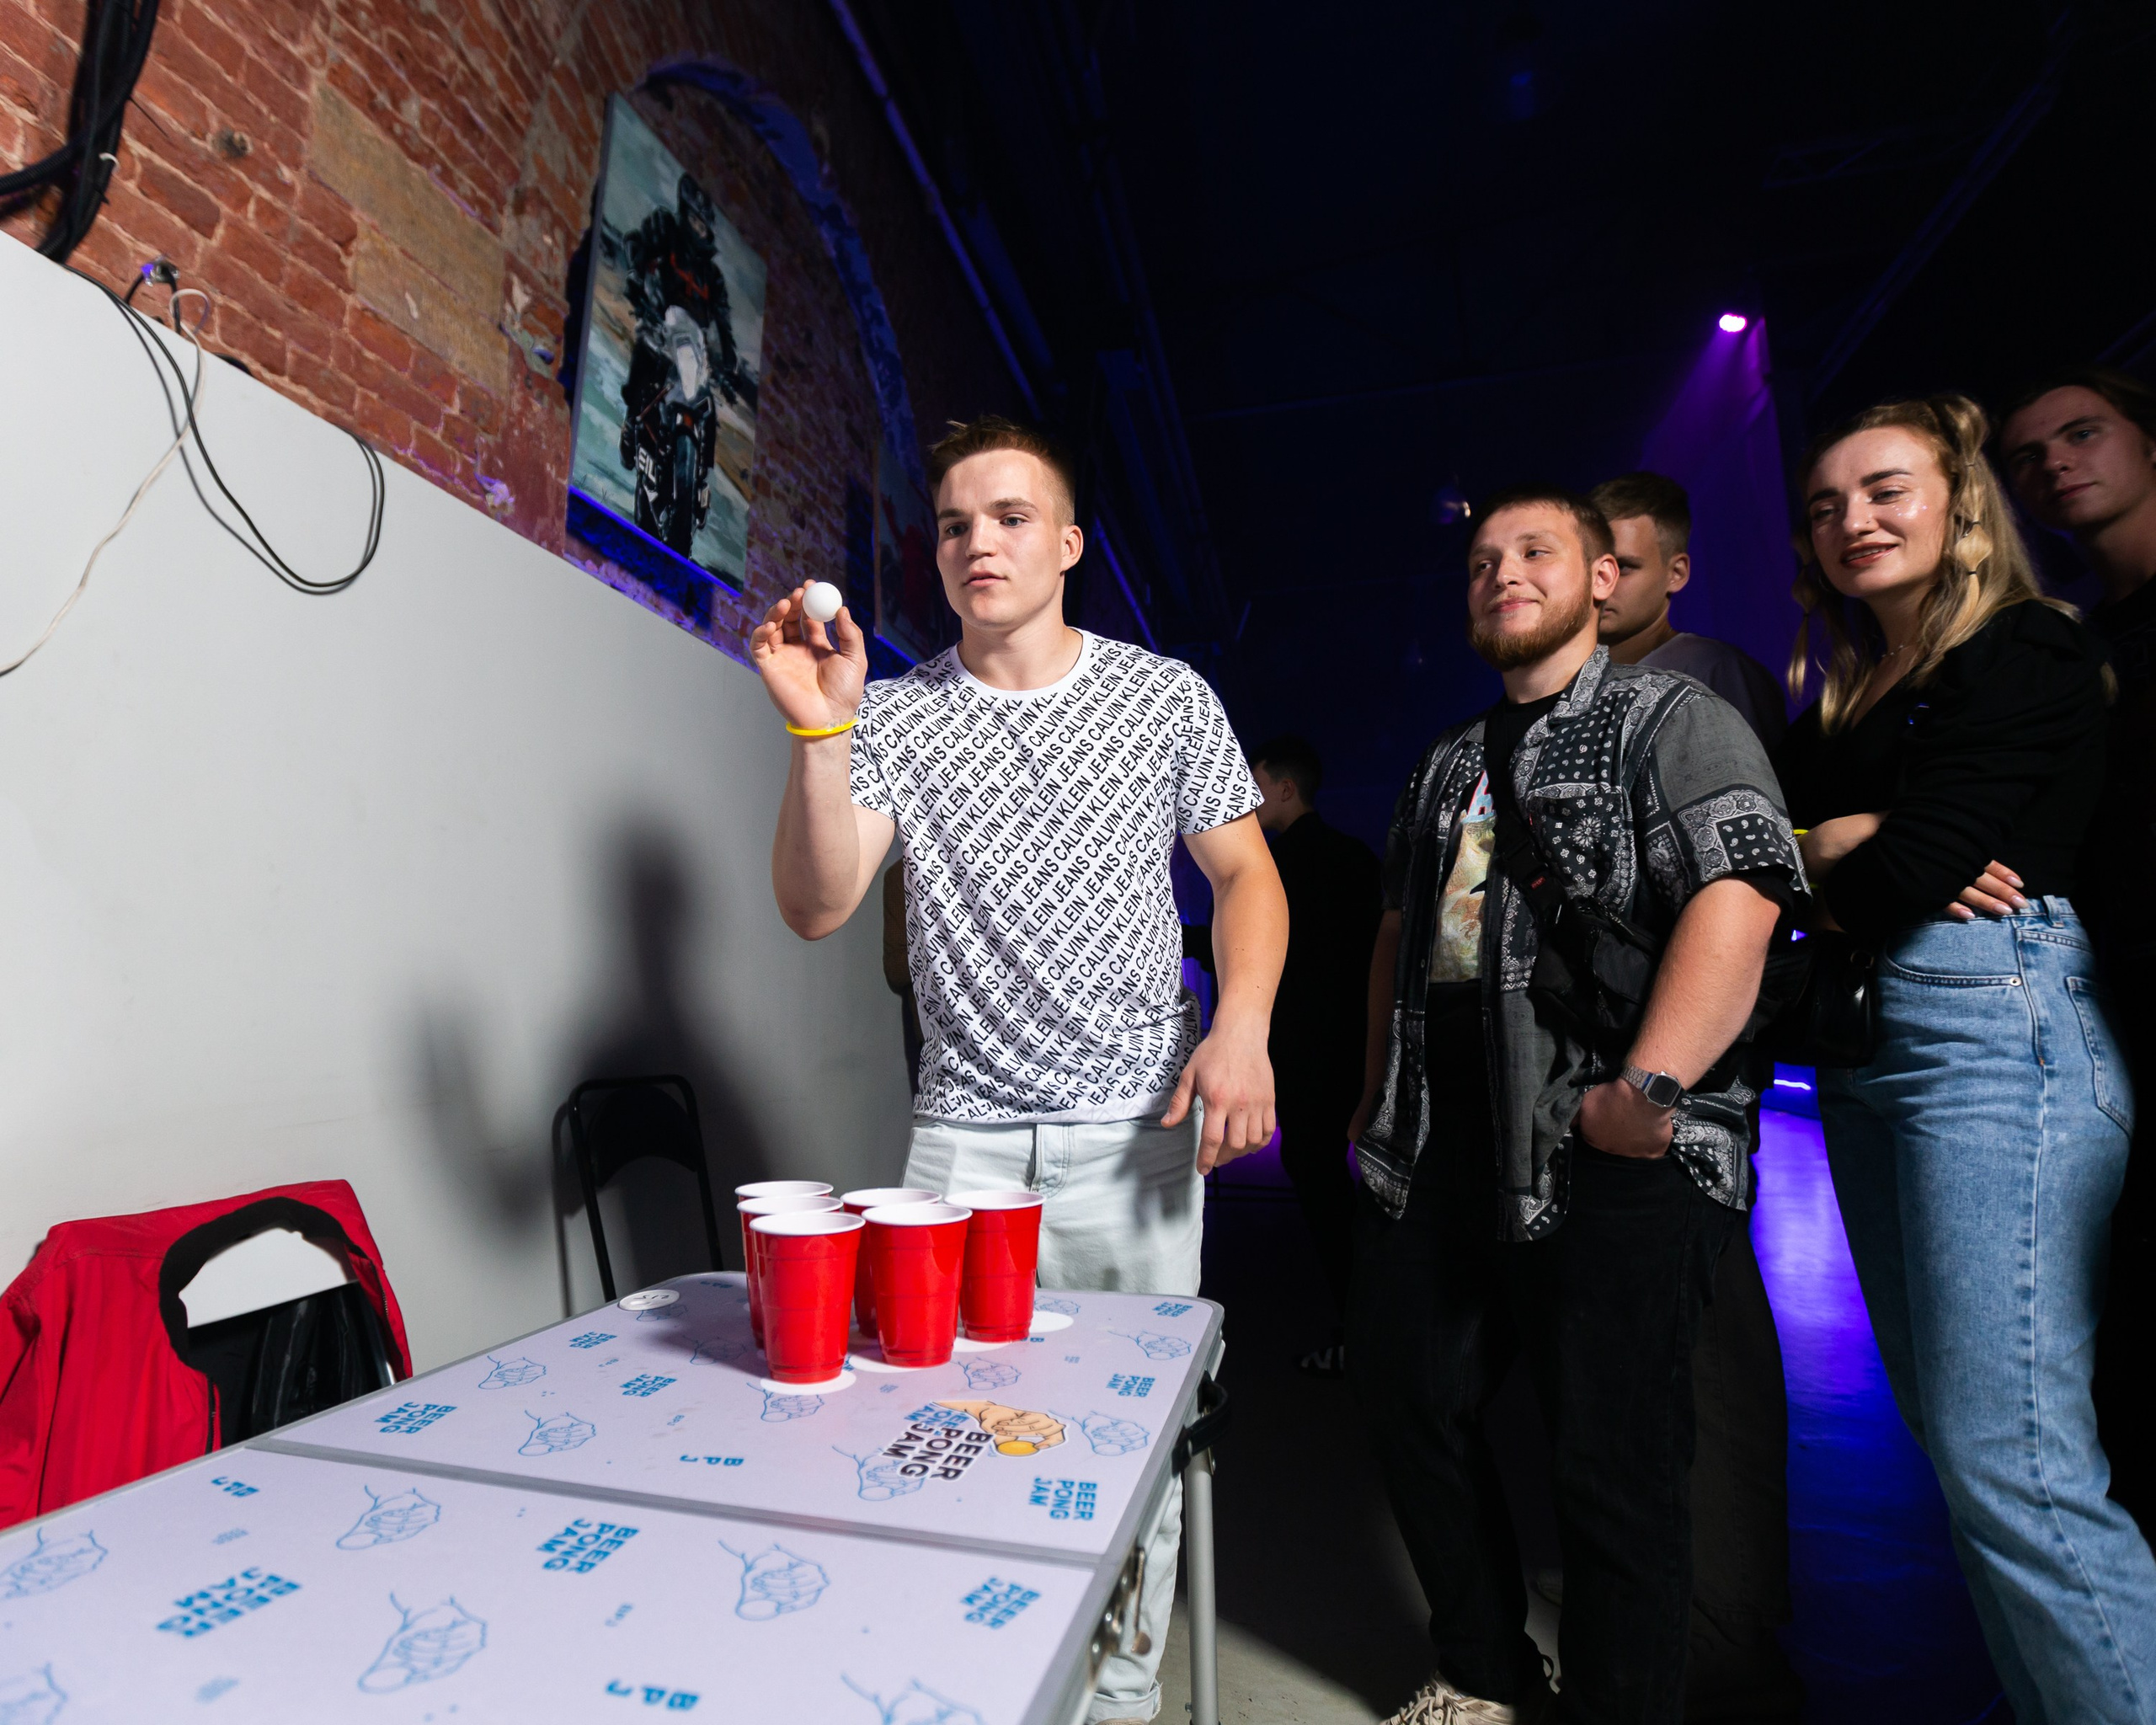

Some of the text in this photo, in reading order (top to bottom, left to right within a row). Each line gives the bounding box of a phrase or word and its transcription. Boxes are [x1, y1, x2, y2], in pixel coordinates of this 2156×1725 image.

[891, 685, 927, 713] KLEIN
[922, 661, 955, 693] JEANS
[884, 710, 925, 748] CALVIN
[921, 689, 952, 715] KLEIN
[1180, 695, 1194, 742] JEANS
[1181, 681, 1209, 770] KLEIN JEANS
[885, 745, 917, 786] JEANS
[914, 713, 953, 748] CALVIN
[910, 783, 942, 824] KLEIN
[940, 747, 975, 788] JEANS
[972, 708, 1008, 749] CALVIN
[911, 746, 946, 788] JEANS
[943, 710, 981, 748] CALVIN
[1182, 756, 1215, 807] CALVIN
[1205, 713, 1225, 756] KLEIN
[913, 818, 943, 861] CALVIN
[937, 783, 972, 824] KLEIN
[970, 747, 1006, 788] JEANS
[1001, 708, 1038, 750] CALVIN
[914, 860, 944, 901] JEANS
[938, 818, 972, 863] CALVIN
[967, 782, 1002, 823] KLEIN
[1001, 745, 1033, 787] JEANS
[1029, 707, 1067, 746] CALVIN
[1060, 675, 1093, 708] KLEIN
[1090, 649, 1121, 679] JEANS
[1193, 796, 1221, 834] EANS
[1211, 745, 1237, 794] CALVIN
[919, 897, 947, 935] KLEIN
[942, 862, 967, 903] JEANS
[962, 819, 1003, 864] CALVIN
[997, 782, 1033, 823] KLEIN
[1029, 744, 1063, 787] JEANS
[1059, 702, 1097, 743] CALVIN
[1091, 673, 1123, 706] KLEIN
[941, 900, 974, 938] KLEIN
[963, 861, 997, 904] JEANS
[993, 817, 1033, 864] CALVIN
[1027, 779, 1061, 821] KLEIN
[1059, 740, 1093, 782] JEANS
[1088, 699, 1126, 740] CALVIN
[1118, 668, 1152, 701] KLEIN
[941, 935, 974, 975] CALVIN
[967, 901, 995, 938] KLEIN
[992, 861, 1027, 905] JEANS
[1023, 814, 1064, 862] CALVIN
[1057, 776, 1092, 819] KLEIN
[1090, 736, 1123, 779] JEANS
[1118, 694, 1154, 737] CALVIN
[1148, 666, 1181, 697] KLEIN
[1222, 783, 1247, 825] EANS
[943, 971, 974, 1009] EANS
[963, 933, 1002, 979] CALVIN
[991, 900, 1026, 940] KLEIN
[1023, 858, 1059, 905] JEANS
[1054, 812, 1094, 860] CALVIN
[1088, 773, 1123, 815] KLEIN
[1119, 734, 1152, 777] JEANS
[1148, 692, 1185, 736] CALVIN
[969, 975, 1000, 1015] JEANS
[995, 936, 1027, 979] CALVIN
[1022, 899, 1056, 940] KLEIN
[1054, 857, 1089, 902] JEANS
[1085, 809, 1122, 857] CALVIN
[1118, 772, 1150, 814] KLEIN
[1146, 733, 1174, 777] JEANS
[970, 1010, 1001, 1046] KLEIN
[991, 974, 1032, 1019] JEANS
[1019, 935, 1058, 981] CALVIN
[1051, 895, 1087, 938] KLEIN
[1086, 853, 1119, 900] JEANS
[1115, 808, 1147, 854] CALVIN
[1142, 771, 1171, 811] KLEIN
[997, 850, 1139, 1049] KLEIN JEANS CALVIN KLEIN JEANS
[1001, 1044, 1033, 1081] ALVIN
[1023, 1013, 1059, 1053] KLEIN
[1052, 976, 1083, 1018] JEANS
[1079, 929, 1118, 977] CALVIN
[1113, 890, 1142, 932] KLEIN
[1054, 1012, 1087, 1050] KLEIN
[1080, 973, 1113, 1015] JEANS
[1109, 926, 1142, 975] CALVIN
[1054, 1041, 1092, 1085] CALVIN
[1085, 1011, 1113, 1048] KLEIN
[1107, 969, 1140, 1012] JEANS
[1135, 920, 1160, 970] CALVIN
[1085, 1041, 1121, 1083] CALVIN
[1135, 964, 1157, 1007] JEANS
[1115, 1031, 1144, 1076] CALVIN
[1153, 959, 1172, 1004] JEANS
[1166, 1015, 1182, 1058] CALVIN
[1143, 1022, 1166, 1067] CALVIN
[620, 1374, 651, 1388] JAM
[622, 1376, 665, 1396] PONG
[635, 1378, 677, 1397] BEER
[1106, 1374, 1126, 1389] JAM
[1118, 1375, 1141, 1396] PONG
[1133, 1377, 1155, 1397] BEER
[375, 1402, 420, 1423] JAM
[379, 1404, 440, 1433] PONG
[398, 1406, 457, 1434] BEER
[679, 1455, 744, 1466] BPJ
[883, 1423, 935, 1459] JAM
[900, 1428, 964, 1477] PONG
[931, 1432, 994, 1480] BEER
[1028, 1477, 1053, 1506] JAM
[1049, 1480, 1075, 1519] PONG
[1073, 1482, 1097, 1521] BEER
[537, 1519, 592, 1551] JAM
[542, 1523, 616, 1570] PONG
[567, 1527, 639, 1573] BEER
